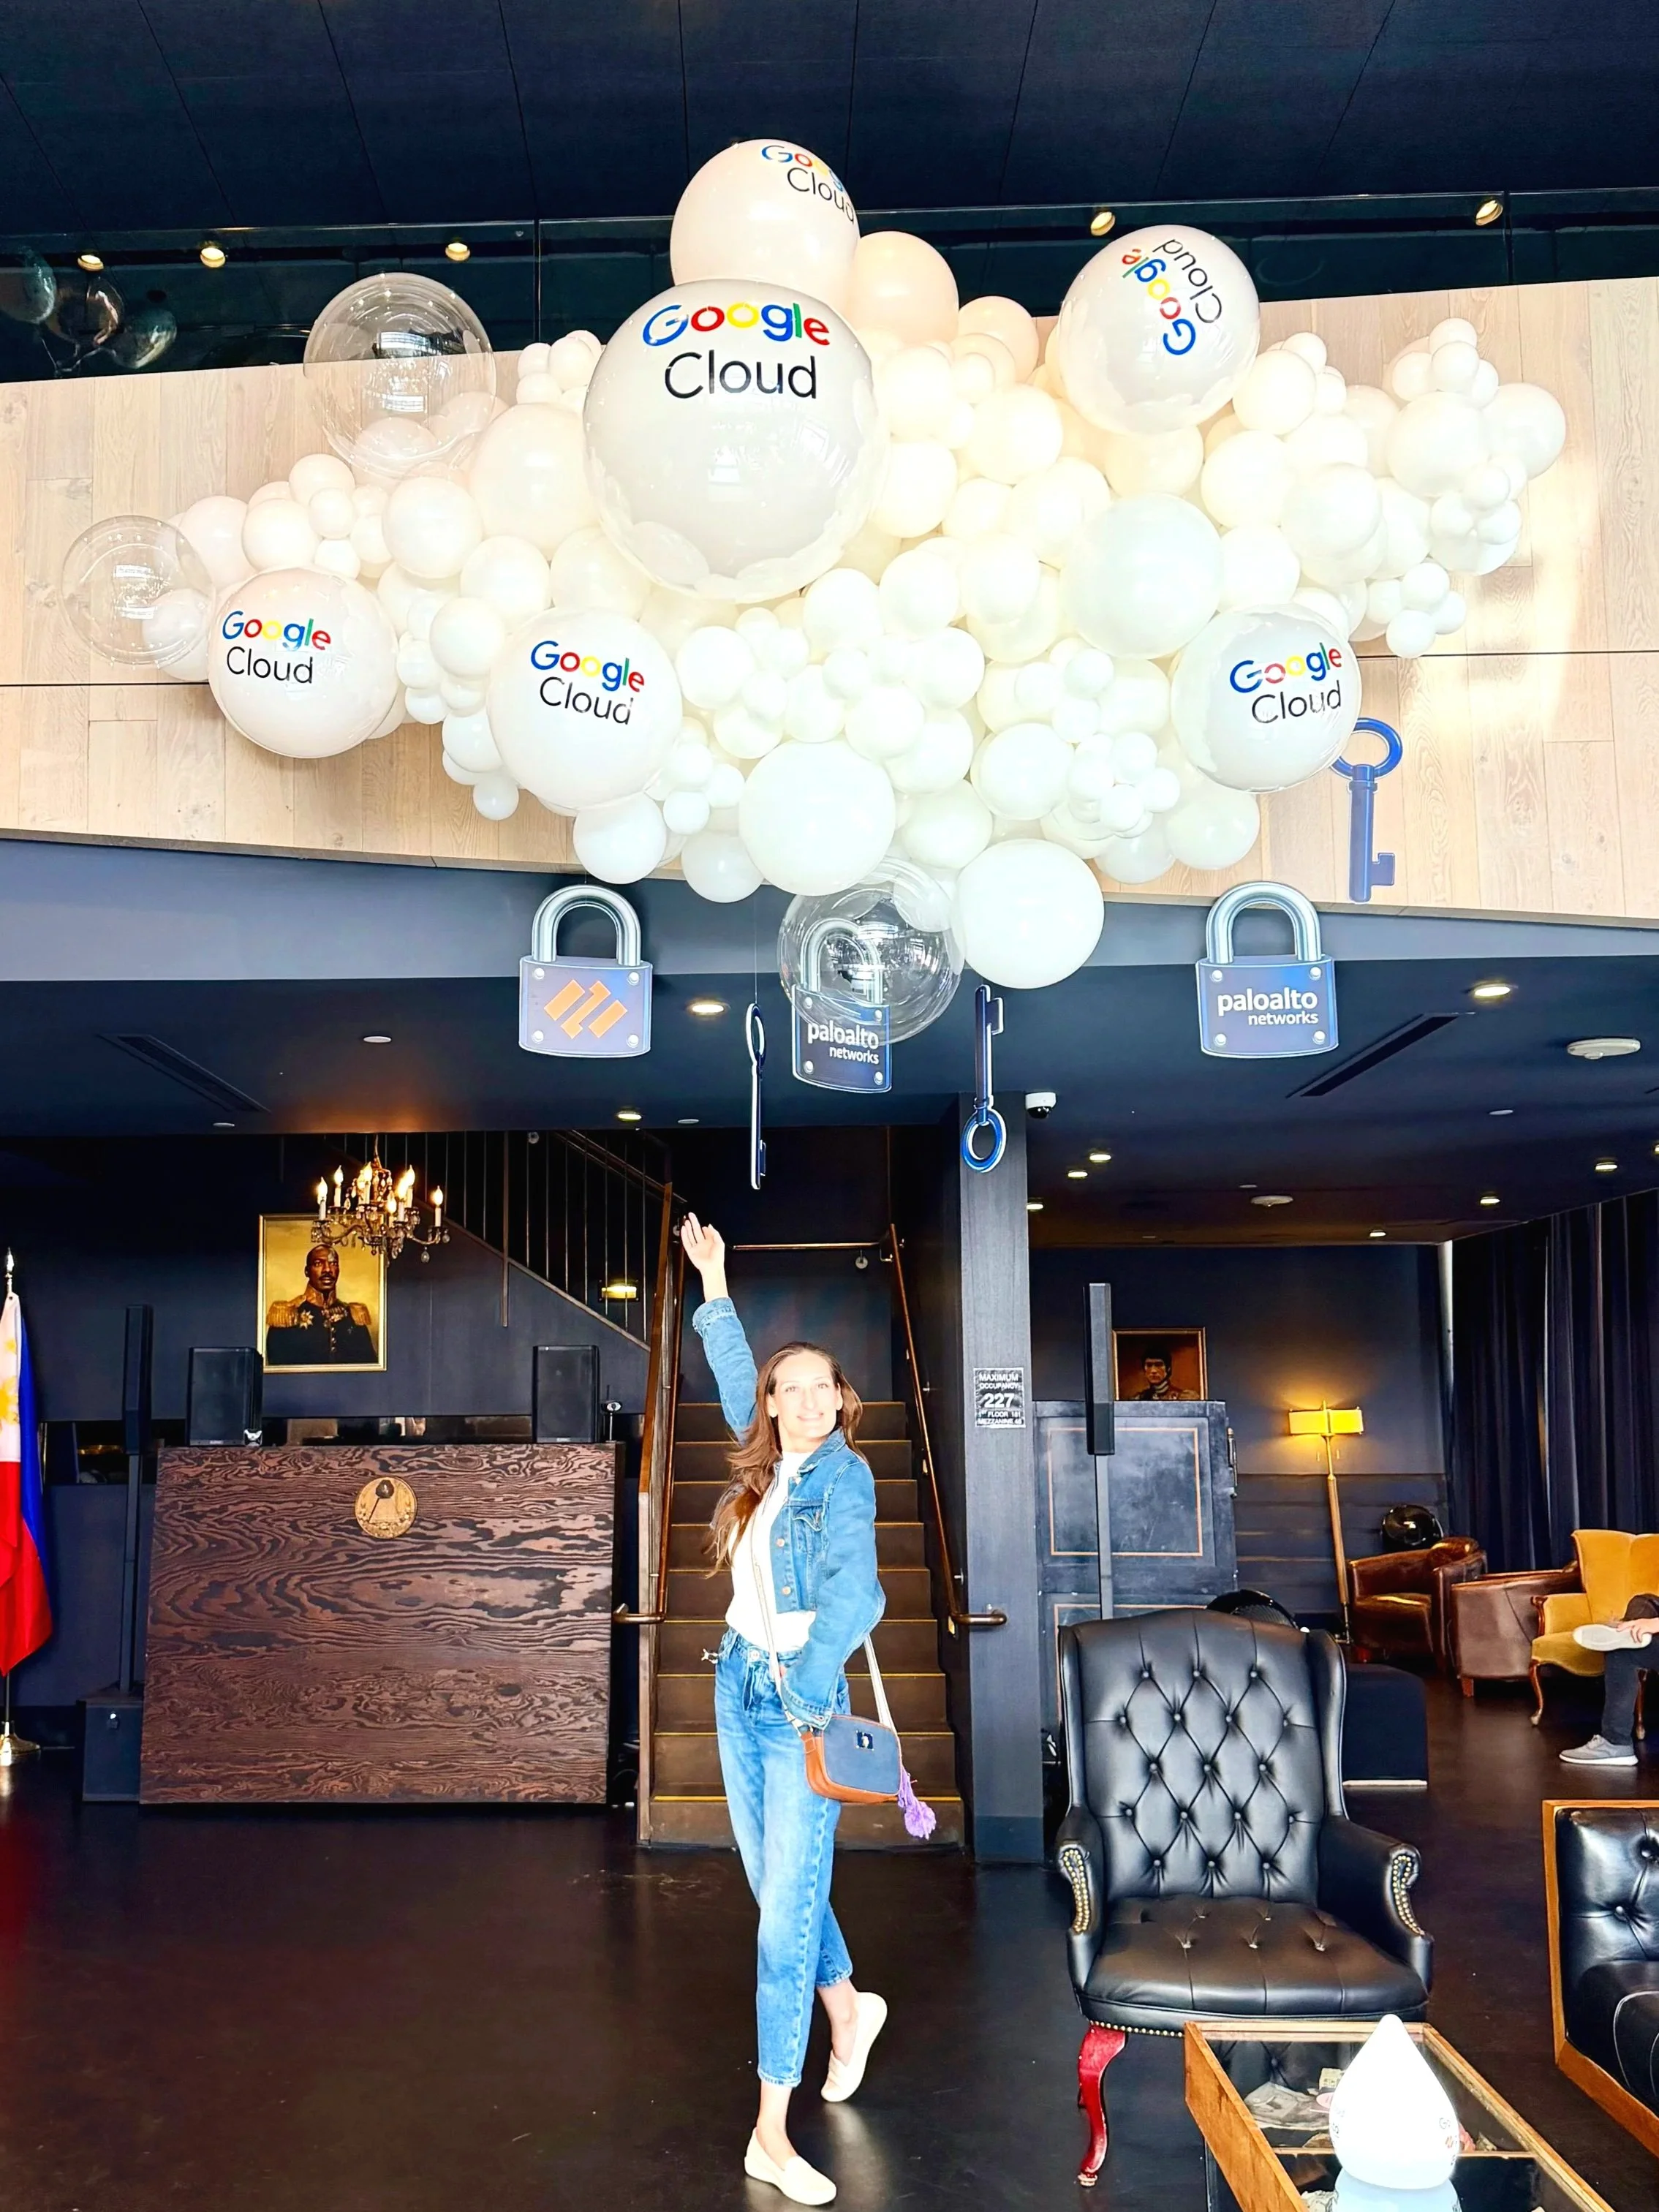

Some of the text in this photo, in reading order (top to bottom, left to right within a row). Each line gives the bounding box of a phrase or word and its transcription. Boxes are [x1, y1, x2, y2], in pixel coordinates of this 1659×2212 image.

[787, 167, 855, 224] Cloud
[1121, 248, 1196, 355] Google
[1152, 239, 1222, 323] Cloud
[642, 301, 831, 347] Google
[664, 350, 817, 399] Cloud
[222, 610, 331, 652] Google
[226, 646, 314, 684] Cloud
[530, 640, 645, 692] Google
[1229, 642, 1342, 693] Google
[539, 676, 634, 725] Cloud
[1251, 679, 1342, 724] Cloud
[1217, 986, 1318, 1017] paloalto
[1247, 1010, 1319, 1026] networks
[807, 1020, 879, 1049] paloalto
[829, 1046, 880, 1065] networks
[979, 1373, 1019, 1382] MAXIMUM
[984, 1392, 1015, 1408] 227
